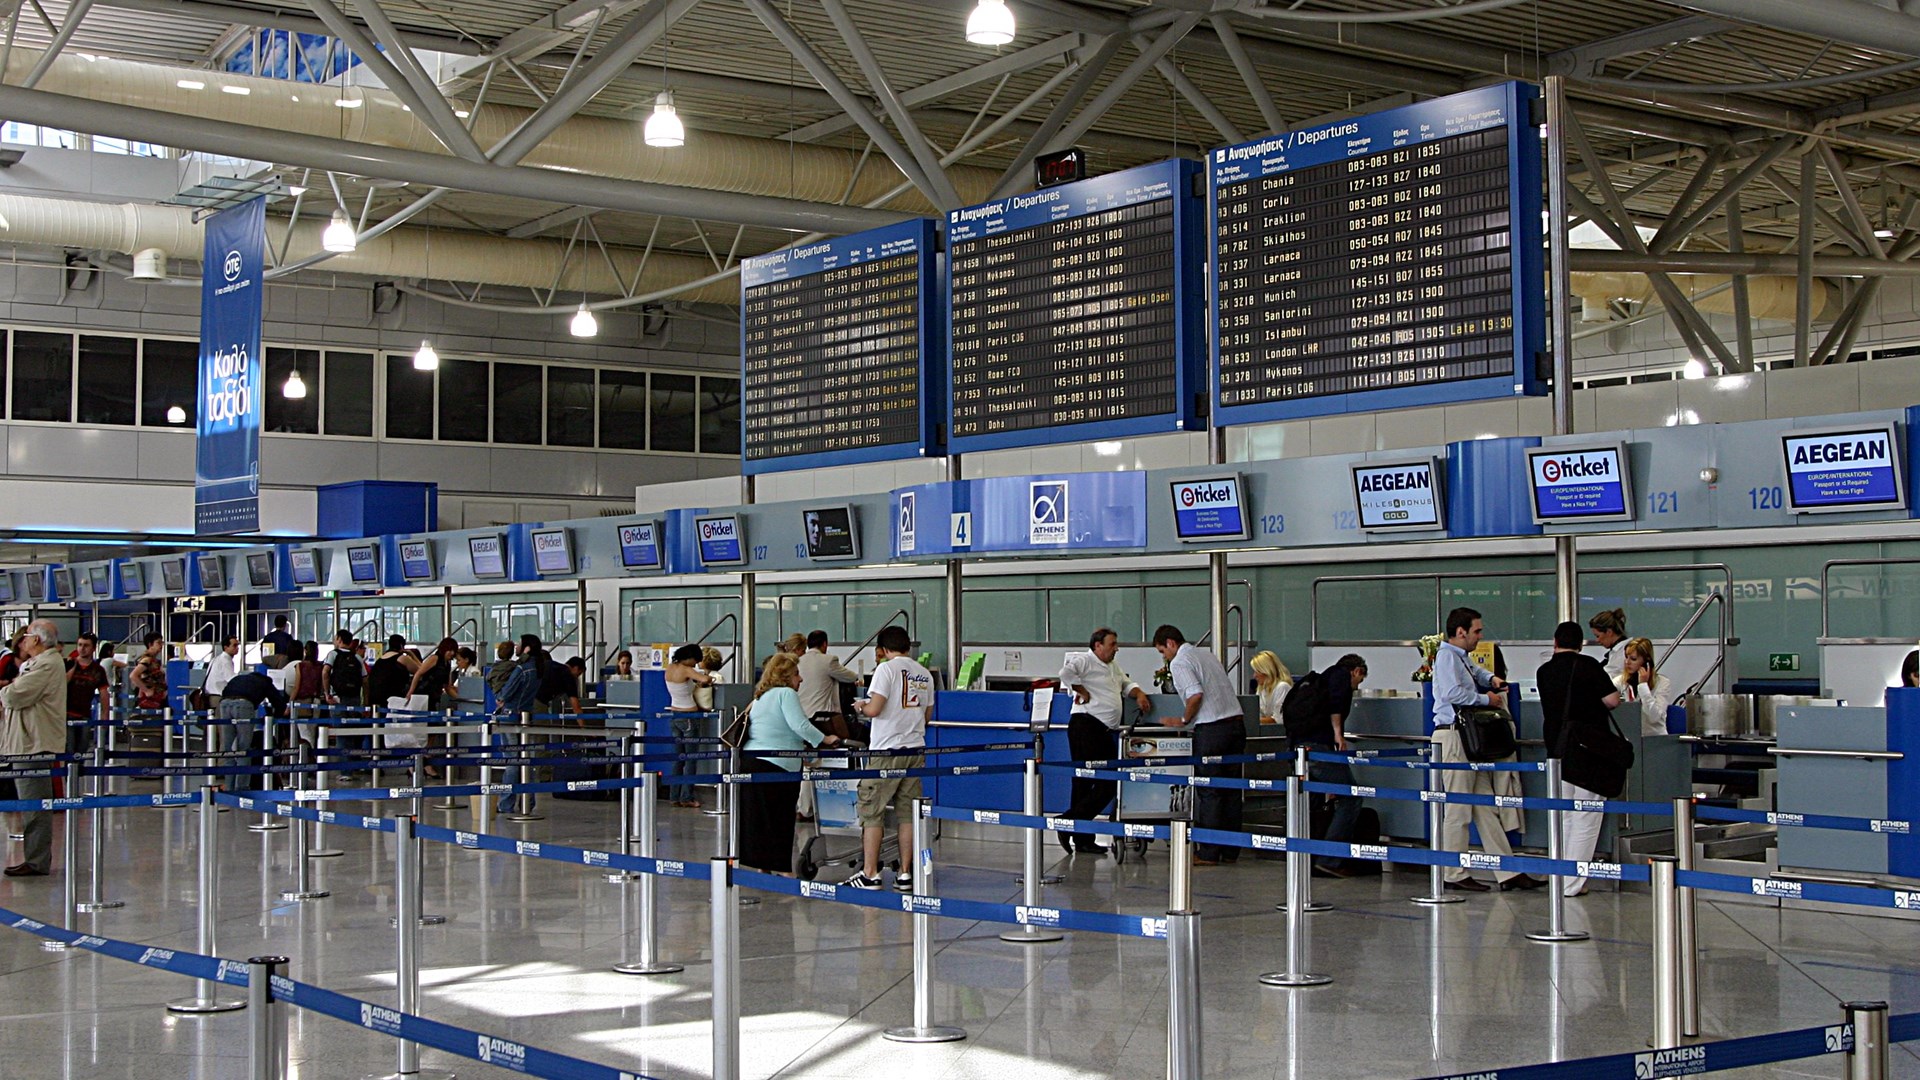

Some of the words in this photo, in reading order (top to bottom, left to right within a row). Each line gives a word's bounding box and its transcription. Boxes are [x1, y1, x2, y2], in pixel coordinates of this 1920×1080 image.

[1228, 139, 1283, 161] Αναχωρήσεις
[1298, 122, 1358, 146] Departures
[1421, 132, 1435, 140] Time
[1348, 146, 1368, 156] Counter
[1232, 183, 1247, 197] 536
[1262, 174, 1293, 191] Chania
[1347, 154, 1387, 173] 083-083
[1417, 143, 1440, 159] 1835
[1232, 202, 1247, 216] 406
[1262, 194, 1288, 210] Corfu
[1348, 173, 1388, 192] 127-133
[1417, 163, 1440, 178] 1840
[960, 202, 1003, 222] Αναχωρήσεις
[1013, 190, 1059, 210] Departures
[1232, 220, 1248, 234] 514
[1262, 210, 1305, 228] Iraklion
[1348, 193, 1388, 212] 083-083
[1417, 183, 1441, 198] 1840
[1232, 239, 1248, 253] 782
[1263, 229, 1305, 247] Skiathos
[1348, 213, 1388, 231] 083-083
[1418, 203, 1441, 218] 1840
[1233, 258, 1248, 271] 337
[1263, 249, 1300, 266] Larnaca
[1349, 233, 1389, 251] 050-054
[1418, 223, 1442, 238] 1845
[1233, 276, 1249, 290] 331
[1263, 268, 1300, 285] Larnaca
[1349, 252, 1389, 270] 079-094
[1419, 243, 1442, 258] 1845
[1233, 294, 1254, 308] 3218
[1264, 287, 1295, 303] Munich
[1350, 272, 1390, 290] 145-151
[1419, 263, 1442, 278] 1855
[1233, 314, 1249, 327] 358
[1264, 304, 1311, 322] Santorini
[1350, 292, 1390, 309] 127-133
[1420, 283, 1443, 299] 1900
[1234, 332, 1249, 346] 319
[1264, 324, 1307, 341] Istanbul
[1350, 312, 1390, 329] 079-094
[1420, 304, 1443, 319] 1900
[1234, 351, 1250, 364] 633
[1265, 345, 1296, 360] London
[1351, 332, 1391, 349] 042-046
[1421, 324, 1444, 339] 1905
[1451, 322, 1475, 335] Late
[1482, 317, 1512, 331] 19:30
[213, 344, 248, 379] Καλό
[1234, 370, 1250, 383] 378
[1265, 363, 1302, 379] Mykonos
[1351, 352, 1391, 368] 127-133
[1421, 344, 1444, 359] 1910
[1235, 388, 1255, 402] 1833
[1265, 383, 1292, 398] Paris
[1351, 372, 1392, 388] 111-114
[1421, 365, 1445, 379] 1910
[208, 376, 251, 425] ταξίδι
[1794, 440, 1885, 465] AEGEAN
[1542, 455, 1610, 482] eticket
[1360, 471, 1429, 492] AEGEAN
[1807, 471, 1873, 480] EUROPE/INTERNATIONAL
[1847, 479, 1869, 487] Required
[1181, 484, 1230, 507] eticket
[1649, 490, 1678, 514] 121
[1749, 487, 1782, 510] 120
[1261, 514, 1284, 534] 123
[1332, 510, 1356, 530] 122
[703, 523, 733, 538] eticket
[956, 515, 966, 544] 4
[1033, 526, 1065, 534] ATHENS
[624, 529, 651, 544] eticket
[473, 541, 498, 553] AEGEAN
[754, 546, 767, 560] 127
[351, 551, 372, 562] AEGEAN
[1158, 740, 1191, 749] Greece
[730, 773, 752, 781] ATHENS
[810, 771, 830, 779] ATHENS
[575, 780, 597, 788] ATHENS
[816, 779, 848, 790] Greece
[53, 797, 83, 806] ATHENS
[163, 792, 192, 800] ATHENS
[1502, 796, 1523, 804] ATHENS
[981, 812, 999, 820] ATHENS
[1777, 813, 1803, 821] ATHENS
[1054, 818, 1074, 828] ATHENS
[1132, 825, 1154, 833] ATHENS
[1881, 820, 1909, 828] ATHENS
[1261, 835, 1286, 845] ATHENS
[1360, 844, 1387, 854] ATHENS
[589, 851, 609, 861] ATHENS
[1471, 855, 1500, 864] ATHENS
[663, 861, 684, 870] ATHENS
[1589, 862, 1621, 872] ATHENS
[810, 882, 836, 892] ATHENS
[1765, 880, 1802, 891] ATHENS
[912, 897, 941, 908] ATHENS
[1027, 908, 1060, 919] ATHENS
[85, 936, 107, 947] ATHENS
[152, 949, 175, 960] ATHENS
[227, 962, 249, 975] ATHENS
[271, 975, 294, 992] ATHENS
[371, 1007, 401, 1023] ATHENS
[491, 1038, 525, 1058] ATHENS
[1654, 1046, 1705, 1064] ATHENS
